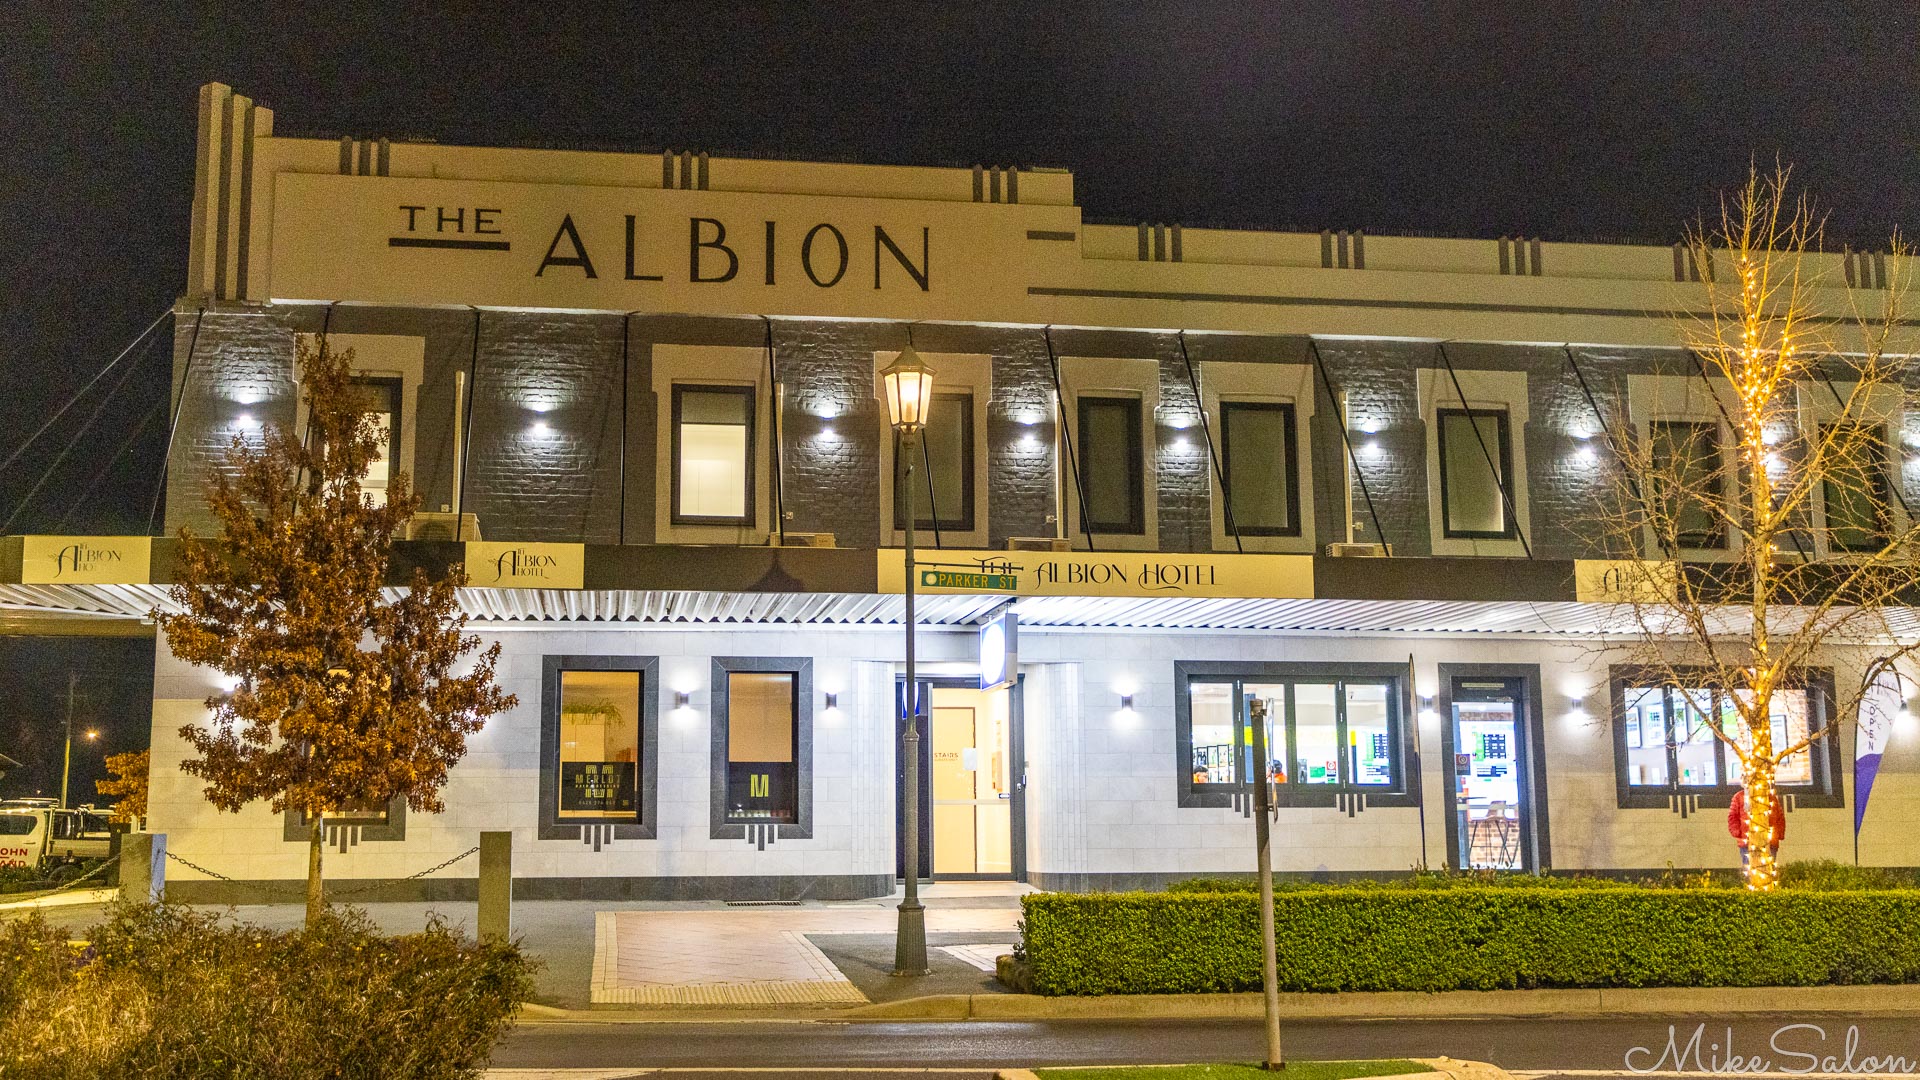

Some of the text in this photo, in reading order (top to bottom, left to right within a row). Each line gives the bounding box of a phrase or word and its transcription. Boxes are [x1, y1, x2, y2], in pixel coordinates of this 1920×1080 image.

[399, 206, 930, 292] THE ALBION
[51, 545, 122, 579] ALBION
[492, 550, 557, 583] ALBION
[1033, 561, 1128, 590] ALBION
[1138, 563, 1223, 591] HOTEL
[939, 573, 1015, 589] PARKER ST
[1868, 705, 1876, 751] OPEN
[575, 774, 620, 784] MERLOT
[750, 774, 769, 798] M
[0, 847, 28, 856] OHN
